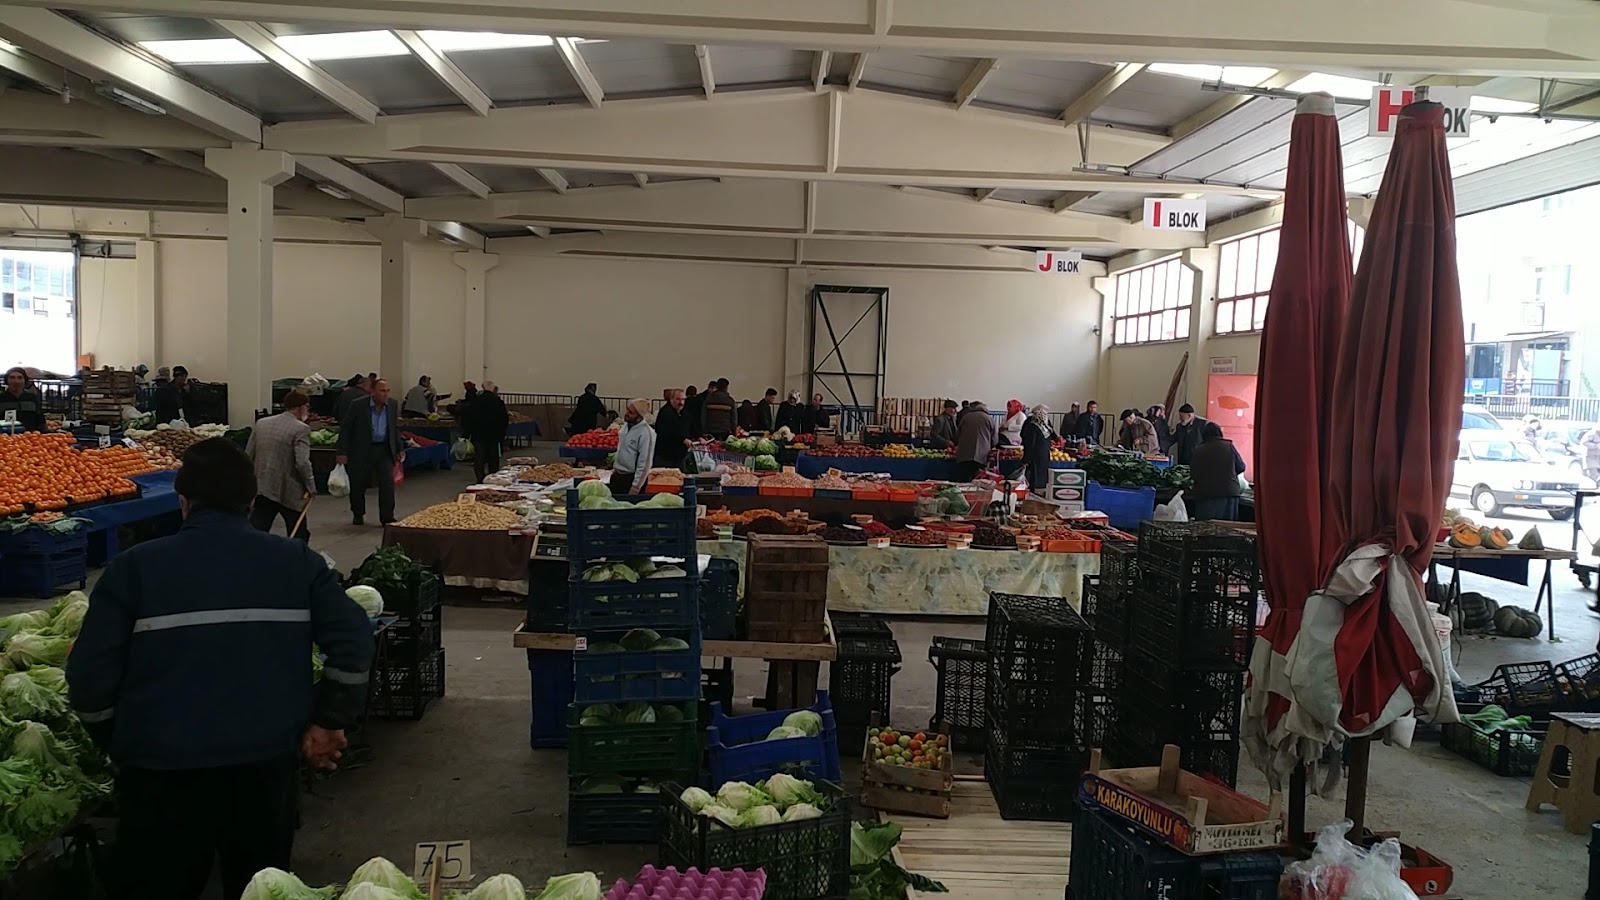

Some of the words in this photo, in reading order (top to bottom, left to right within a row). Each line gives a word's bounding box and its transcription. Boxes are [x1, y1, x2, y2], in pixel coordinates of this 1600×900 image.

[1378, 90, 1413, 132] H
[1153, 201, 1161, 227] I
[1169, 212, 1199, 228] BLOK
[1039, 253, 1053, 271] J
[1057, 260, 1079, 273] BLOK
[1096, 784, 1172, 836] KARAKOYUNLU
[419, 843, 463, 879] 75
